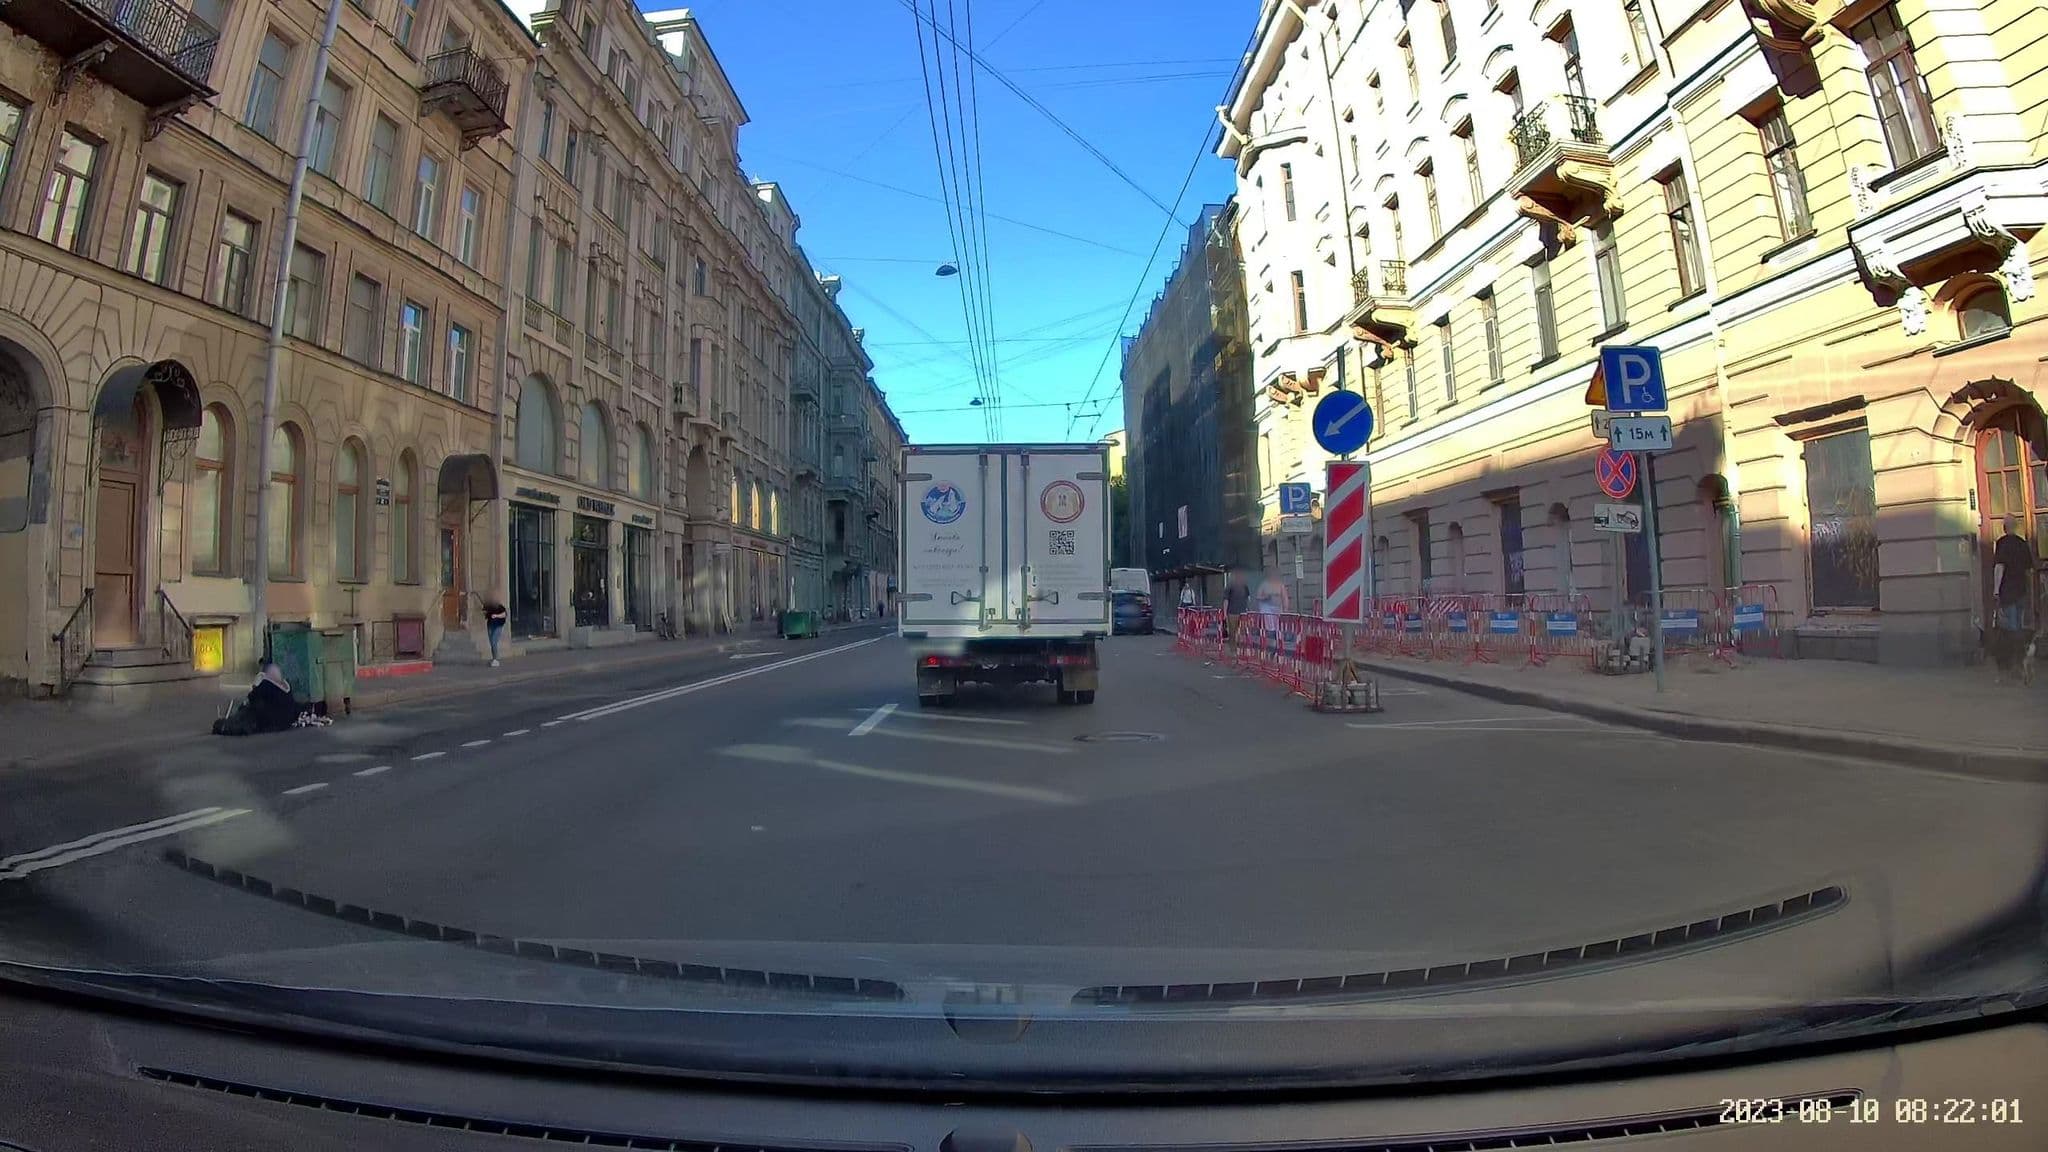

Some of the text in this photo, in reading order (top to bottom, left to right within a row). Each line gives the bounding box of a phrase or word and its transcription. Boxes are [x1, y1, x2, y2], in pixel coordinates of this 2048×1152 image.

[1618, 354, 1651, 404] P
[1629, 427, 1654, 440] 15м
[1288, 486, 1306, 510] P
